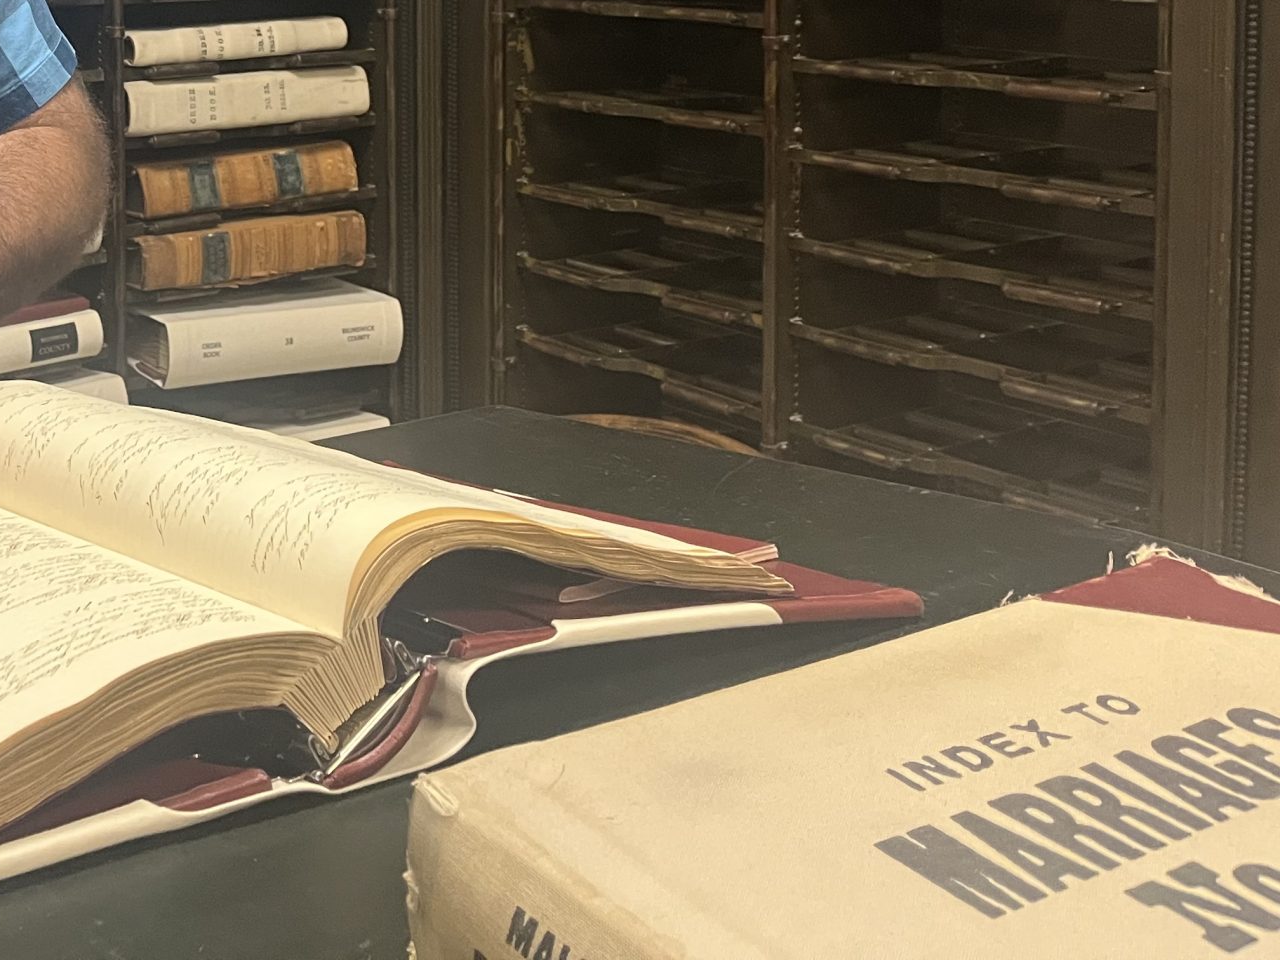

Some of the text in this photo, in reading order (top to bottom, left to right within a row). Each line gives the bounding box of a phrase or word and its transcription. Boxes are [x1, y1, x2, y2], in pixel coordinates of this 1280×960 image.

[38, 342, 71, 356] COUNTY
[885, 694, 1141, 791] INDEX TO
